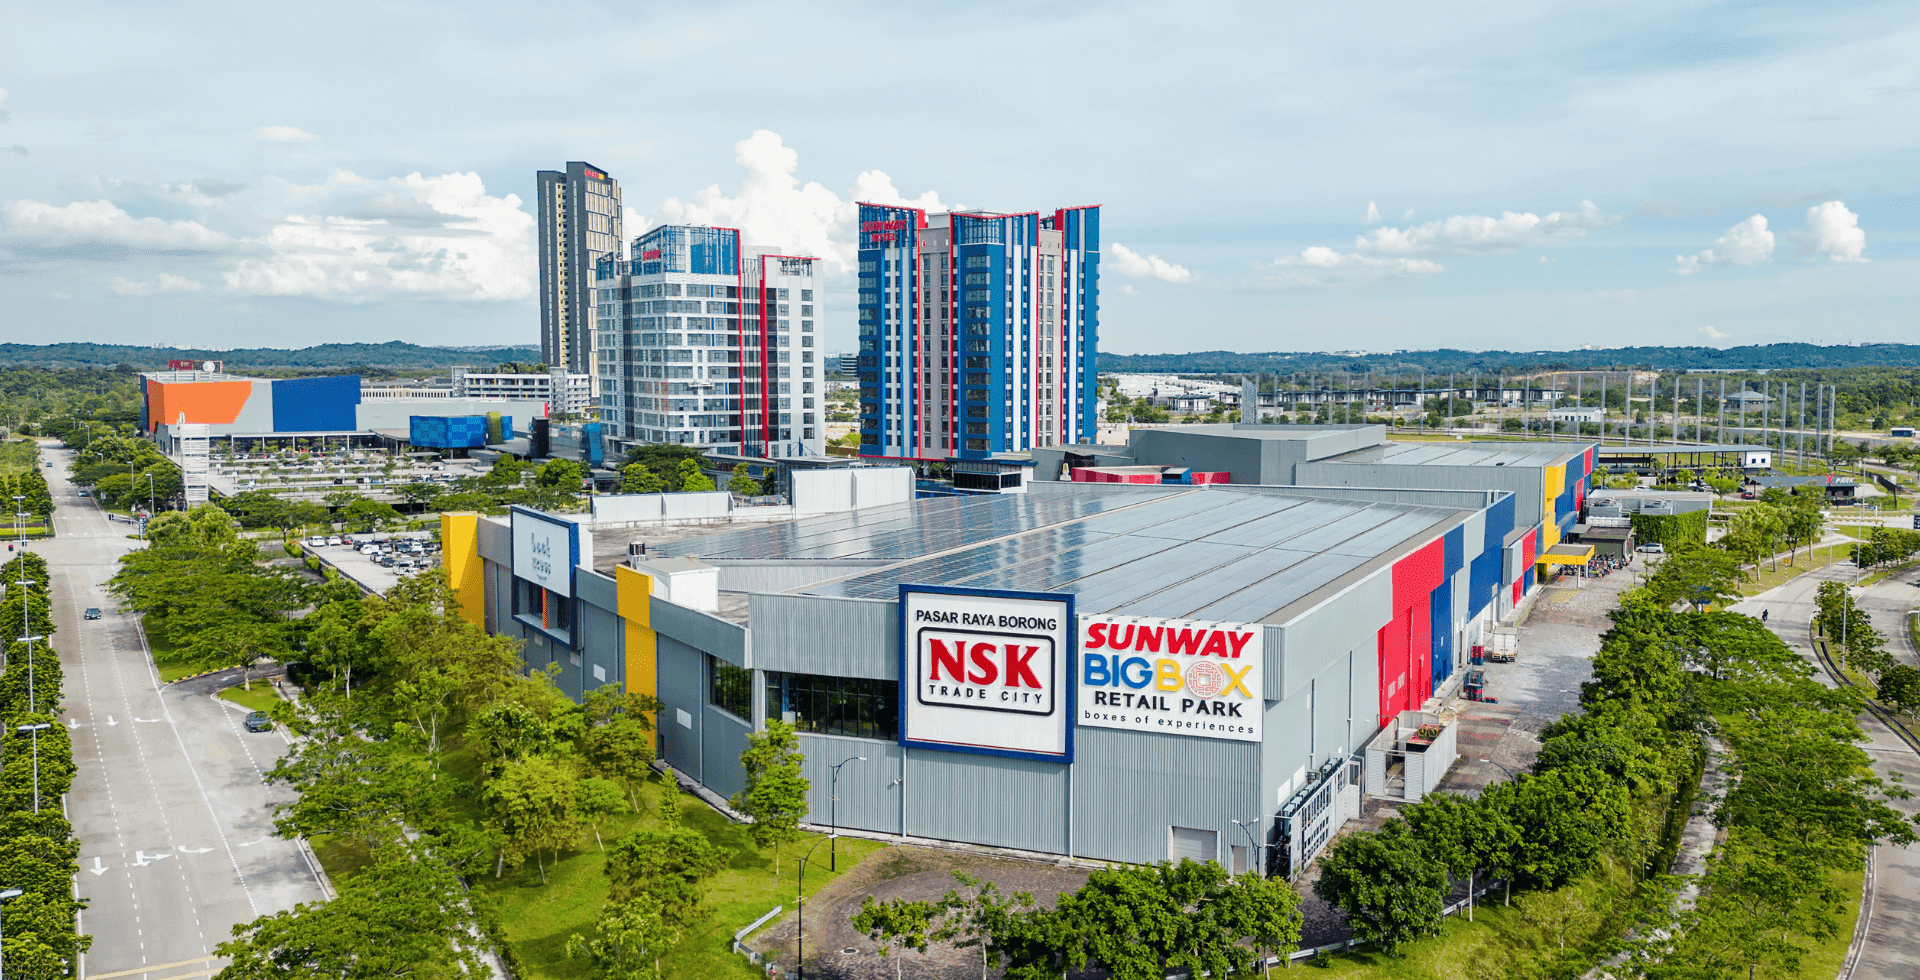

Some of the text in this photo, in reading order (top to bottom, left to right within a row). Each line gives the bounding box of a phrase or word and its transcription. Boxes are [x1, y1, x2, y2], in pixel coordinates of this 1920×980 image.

[862, 220, 906, 232] SUNWAY
[871, 233, 897, 241] HOTEL
[1836, 476, 1855, 484] PARK
[916, 609, 1057, 630] PASAR RAYA BORONG
[1085, 622, 1254, 658] SUNWAY
[928, 638, 1043, 689] NSK
[929, 684, 1042, 704] TRADE CITY
[1095, 690, 1243, 718] RETAIL PARK
[1084, 710, 1254, 735] boxes of experiences
